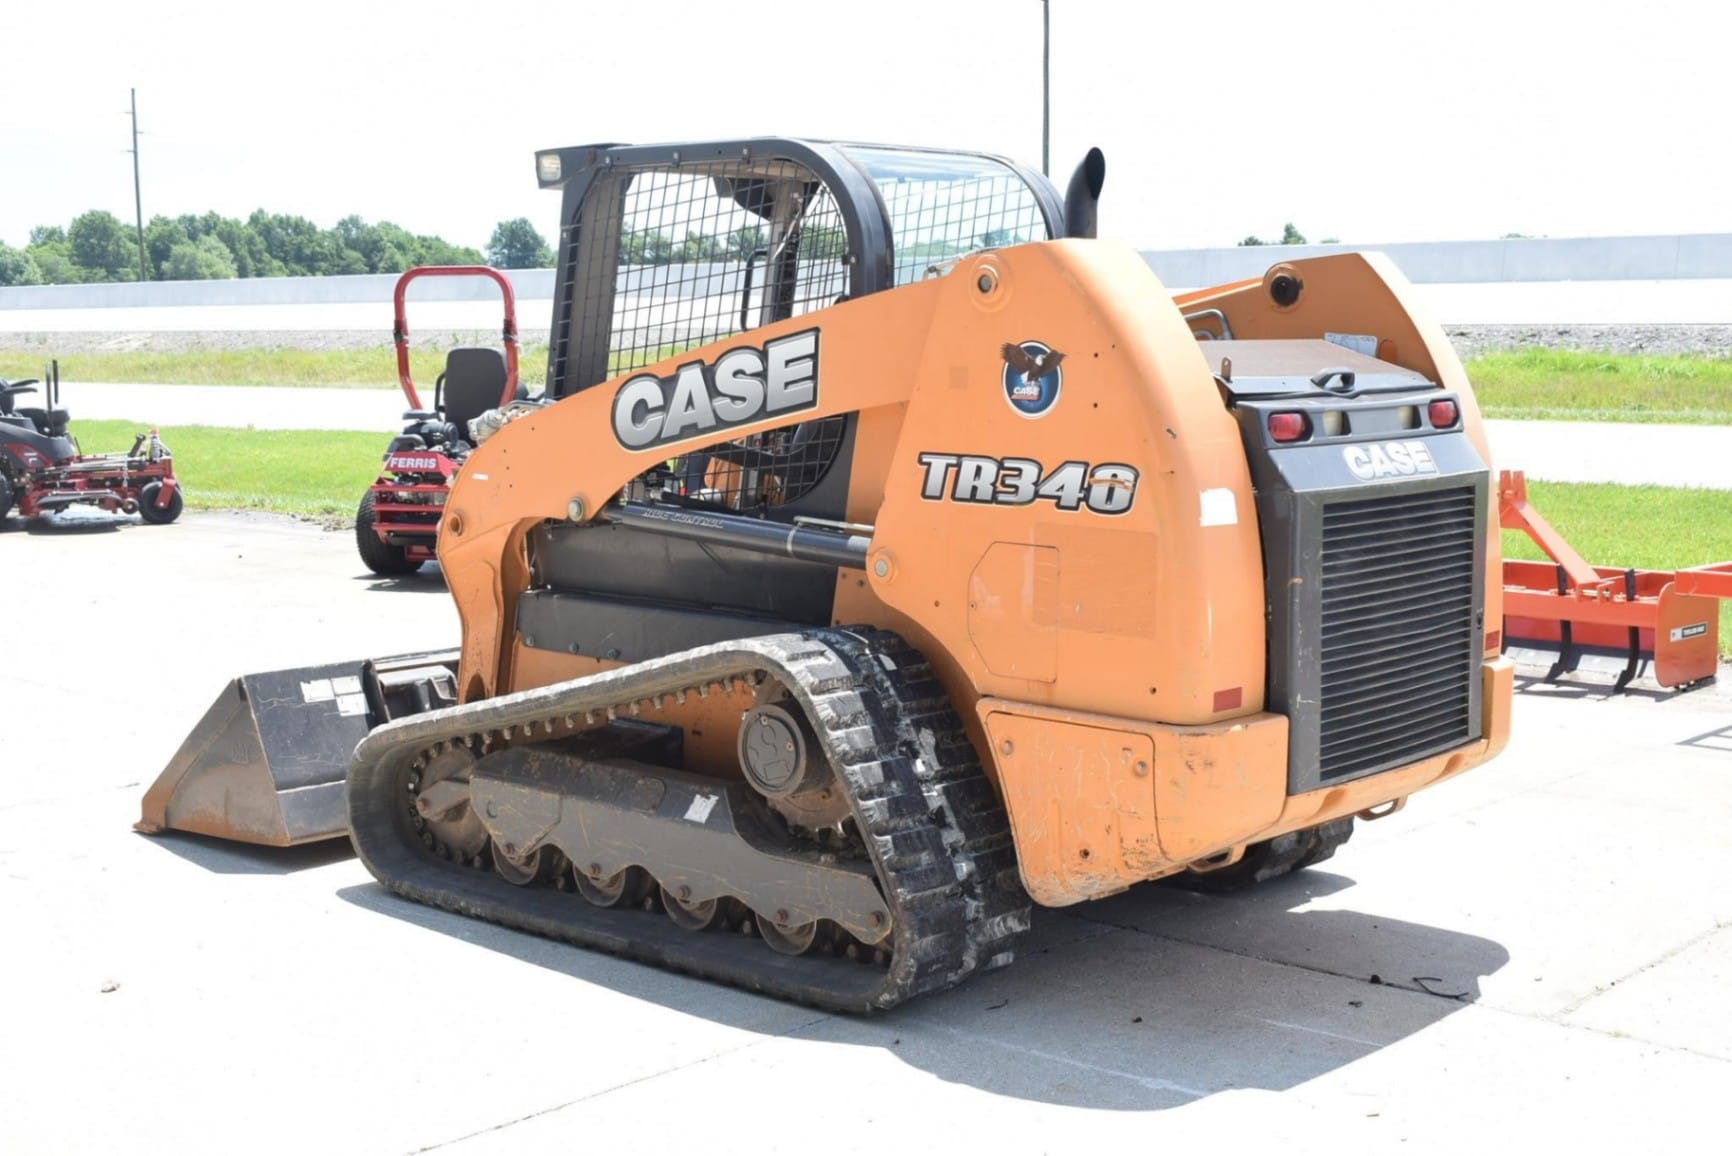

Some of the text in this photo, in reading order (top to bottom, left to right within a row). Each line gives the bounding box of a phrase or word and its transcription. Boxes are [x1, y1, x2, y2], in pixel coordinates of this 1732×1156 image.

[613, 331, 818, 448] CASE
[390, 457, 436, 469] FERRIS
[1343, 442, 1438, 480] CASE
